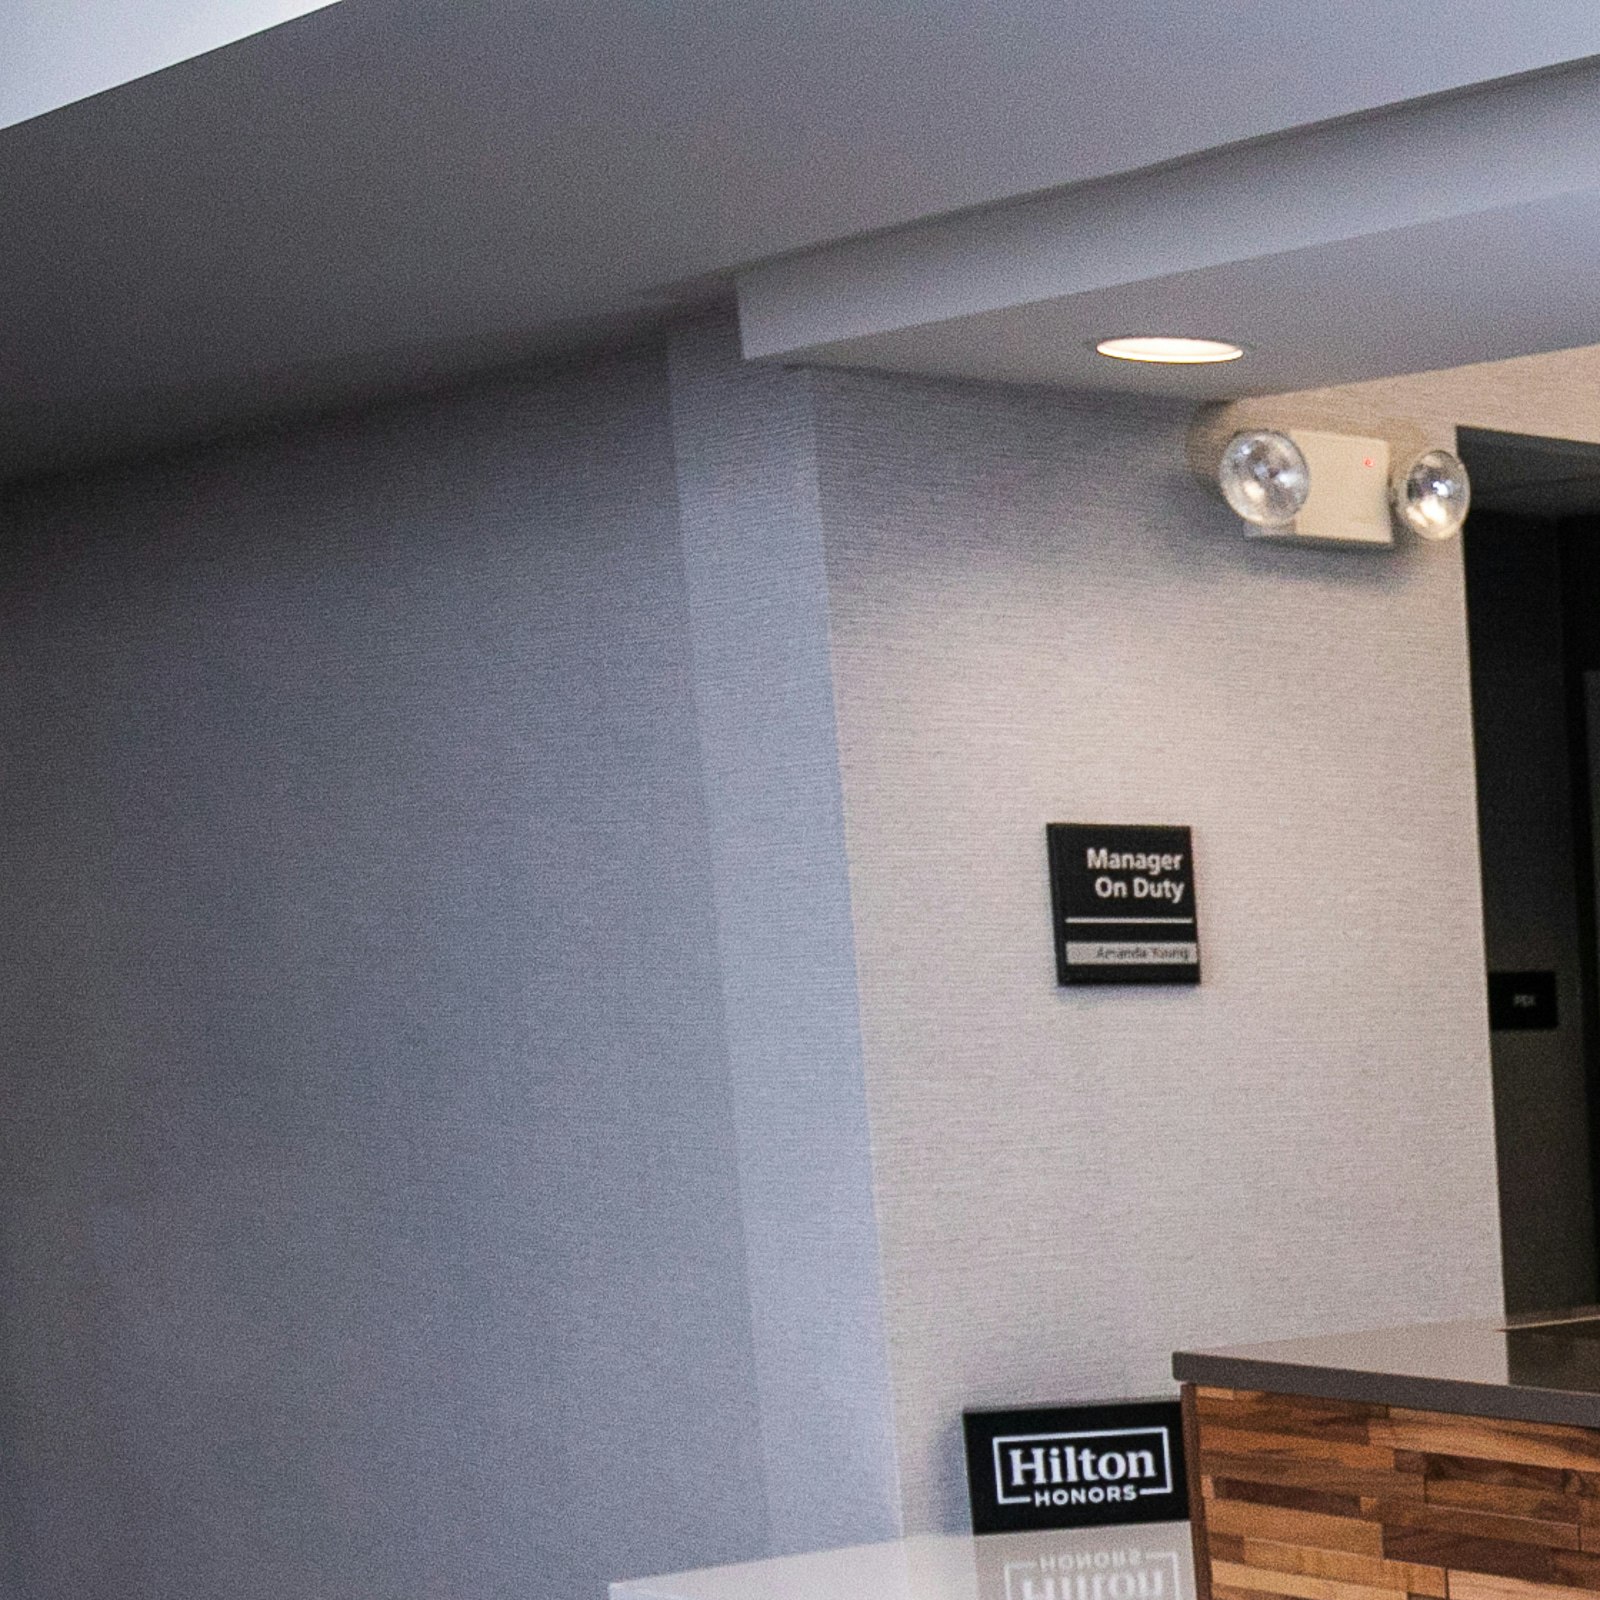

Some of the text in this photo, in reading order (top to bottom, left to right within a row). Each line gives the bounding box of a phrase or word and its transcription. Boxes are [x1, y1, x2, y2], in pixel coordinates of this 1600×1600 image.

[1086, 847, 1184, 875] Manager
[1094, 876, 1185, 904] On Duty
[1008, 1445, 1158, 1486] Hilton
[1033, 1484, 1138, 1507] HONORS
